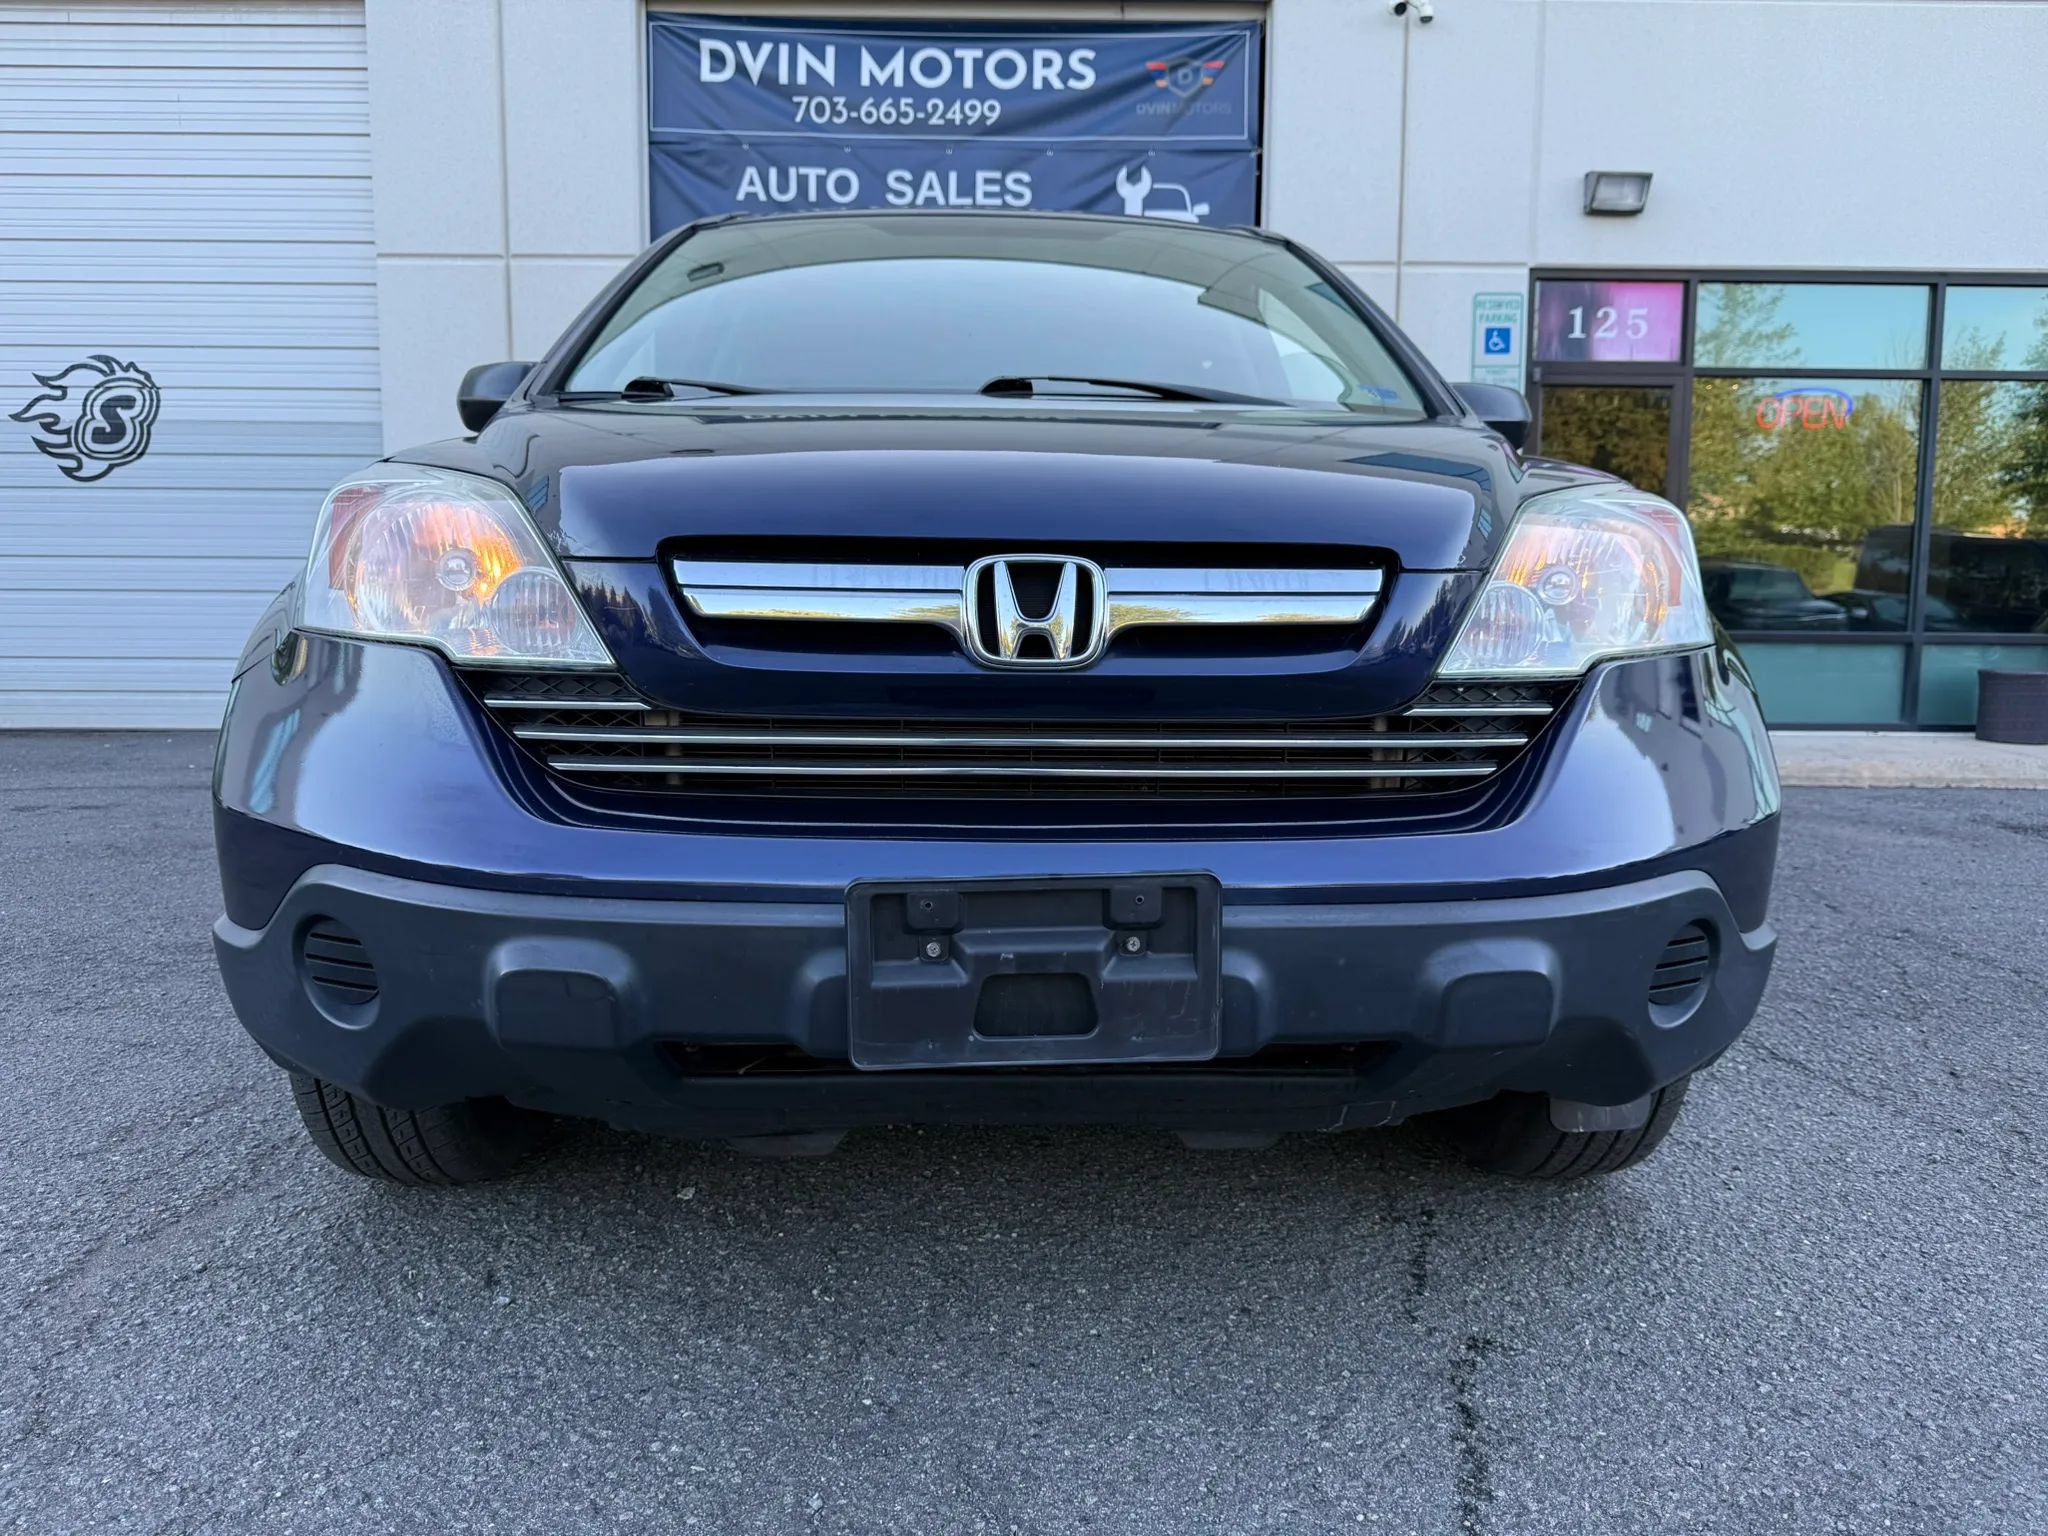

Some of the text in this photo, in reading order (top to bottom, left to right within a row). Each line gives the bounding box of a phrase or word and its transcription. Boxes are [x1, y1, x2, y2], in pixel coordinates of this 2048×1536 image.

[699, 38, 1098, 91] DVIN MOTORS
[792, 96, 1001, 127] 703-665-2499
[736, 166, 1033, 207] AUTO SALES
[1568, 305, 1648, 339] 125
[1756, 396, 1847, 431] OPEN
